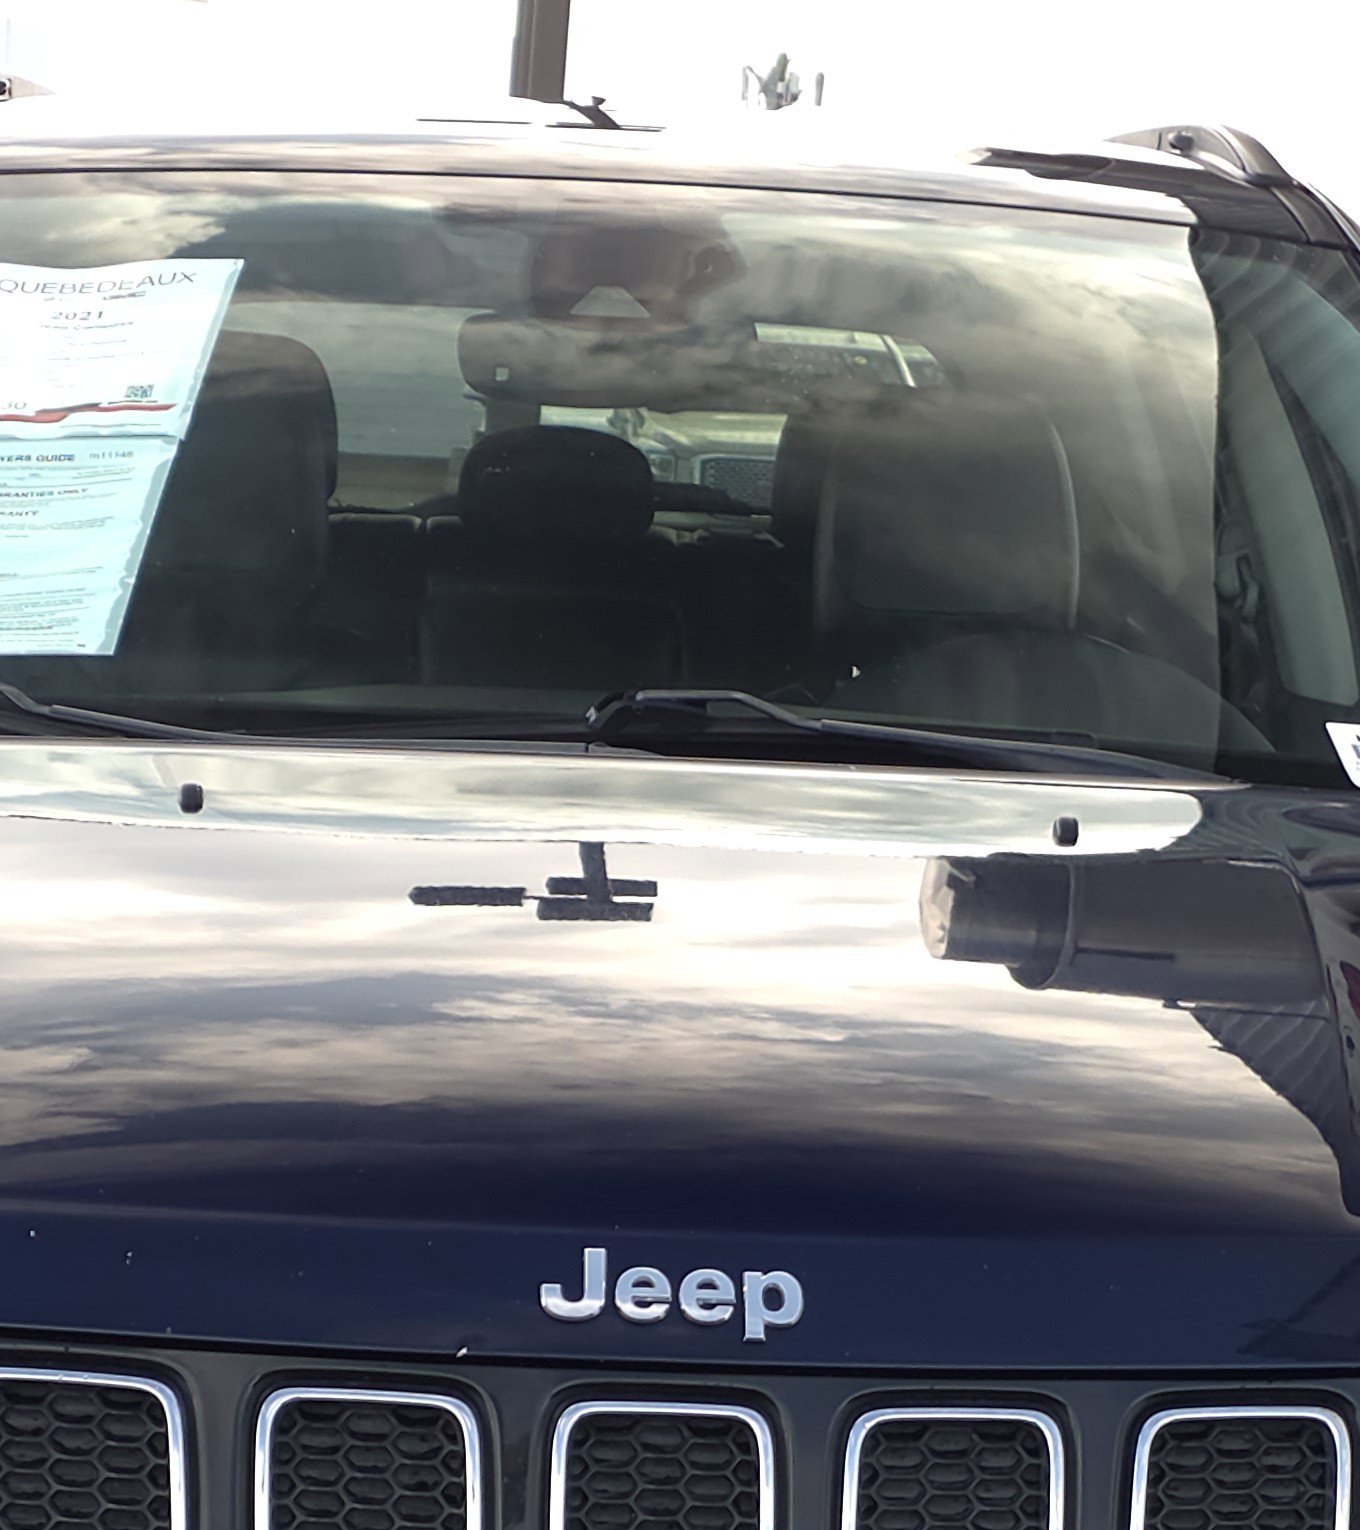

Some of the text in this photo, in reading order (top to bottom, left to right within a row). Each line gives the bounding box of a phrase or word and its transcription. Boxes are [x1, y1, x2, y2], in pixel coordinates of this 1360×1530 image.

[51, 310, 104, 321] 2021
[36, 453, 76, 462] GUIDE
[540, 1246, 804, 1343] Jeep
